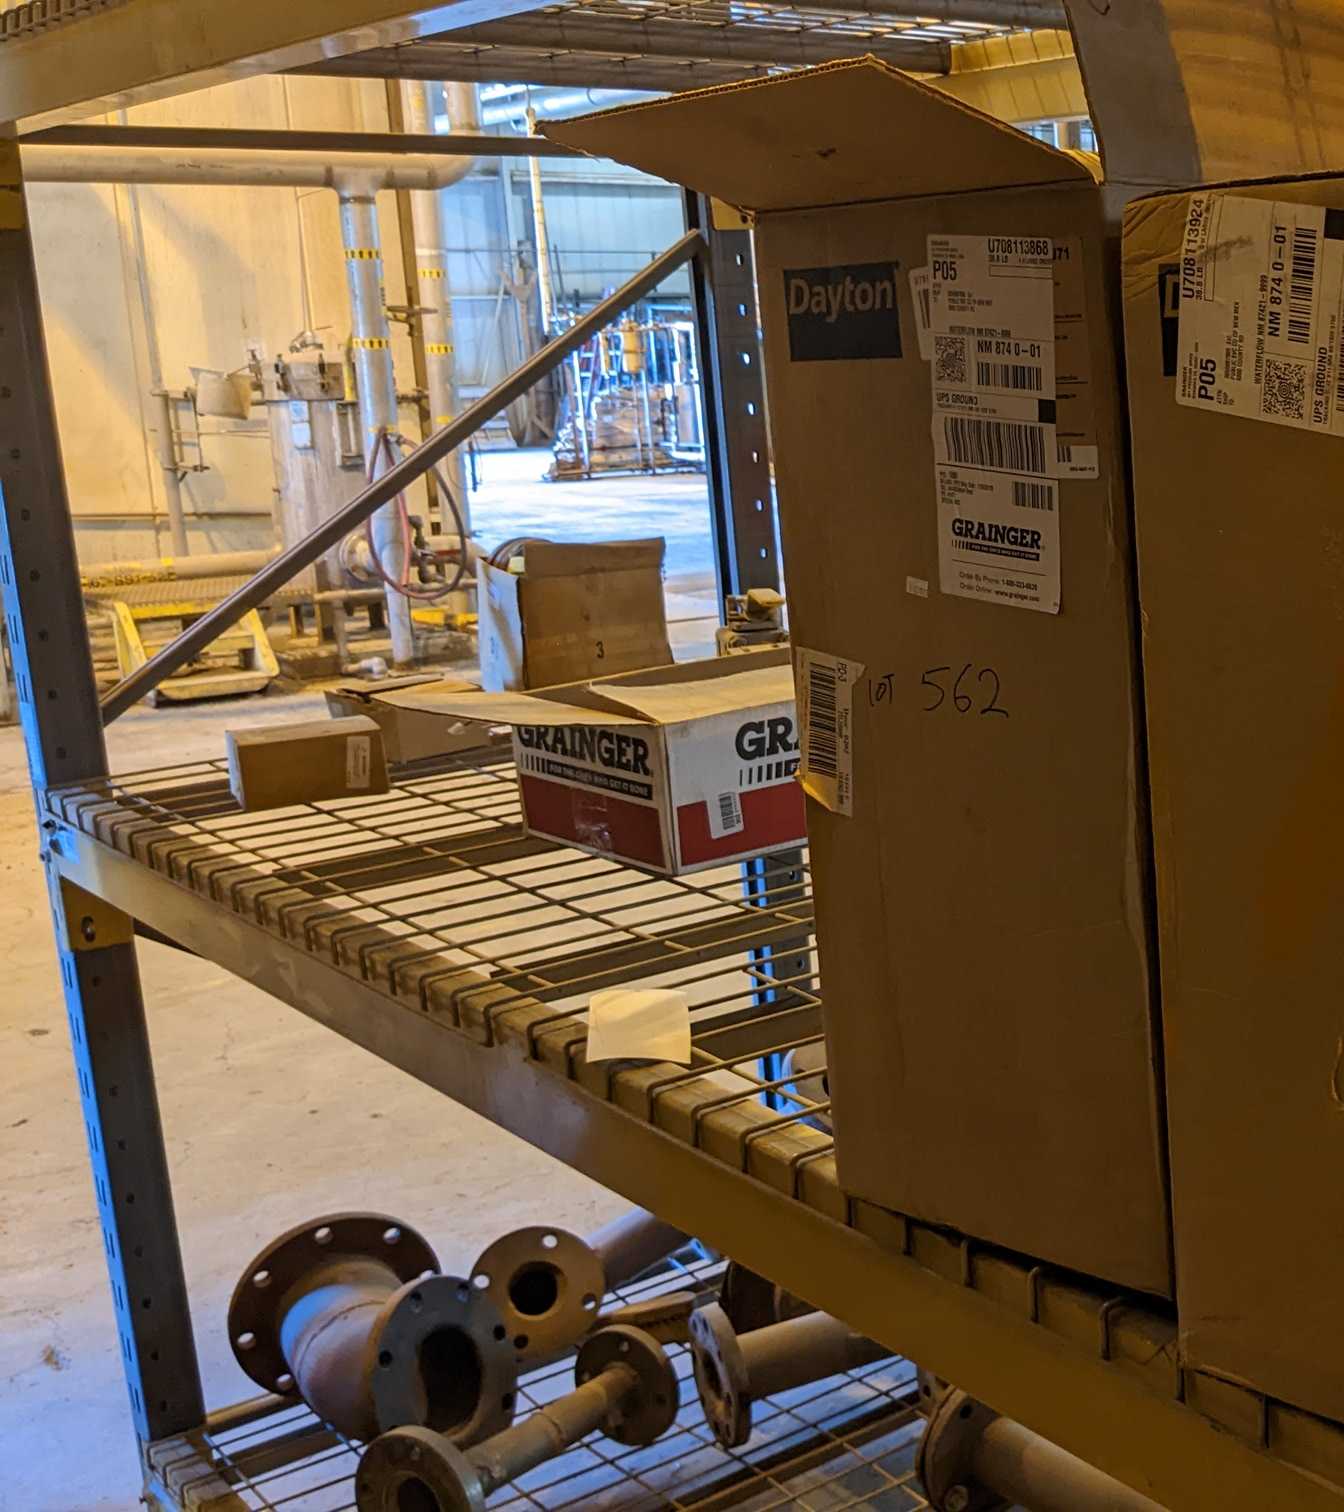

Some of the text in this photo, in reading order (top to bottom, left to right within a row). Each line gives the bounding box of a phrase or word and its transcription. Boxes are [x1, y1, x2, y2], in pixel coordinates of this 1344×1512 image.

[933, 261, 957, 280] P05
[1182, 199, 1204, 299] U708113924
[790, 275, 894, 322] Dayton
[1269, 278, 1283, 305] 874
[1268, 311, 1281, 337] NM
[977, 340, 992, 353] NM
[995, 342, 1011, 355] 874
[1254, 337, 1266, 384] WATERFLOW
[1198, 358, 1216, 401] P05
[1313, 346, 1328, 424] UPS GROUND
[951, 518, 1041, 550] GRAINGER
[596, 641, 605, 659] 3
[921, 664, 1009, 719] 562
[517, 725, 650, 776] GRAINGER
[735, 717, 800, 761] GR
